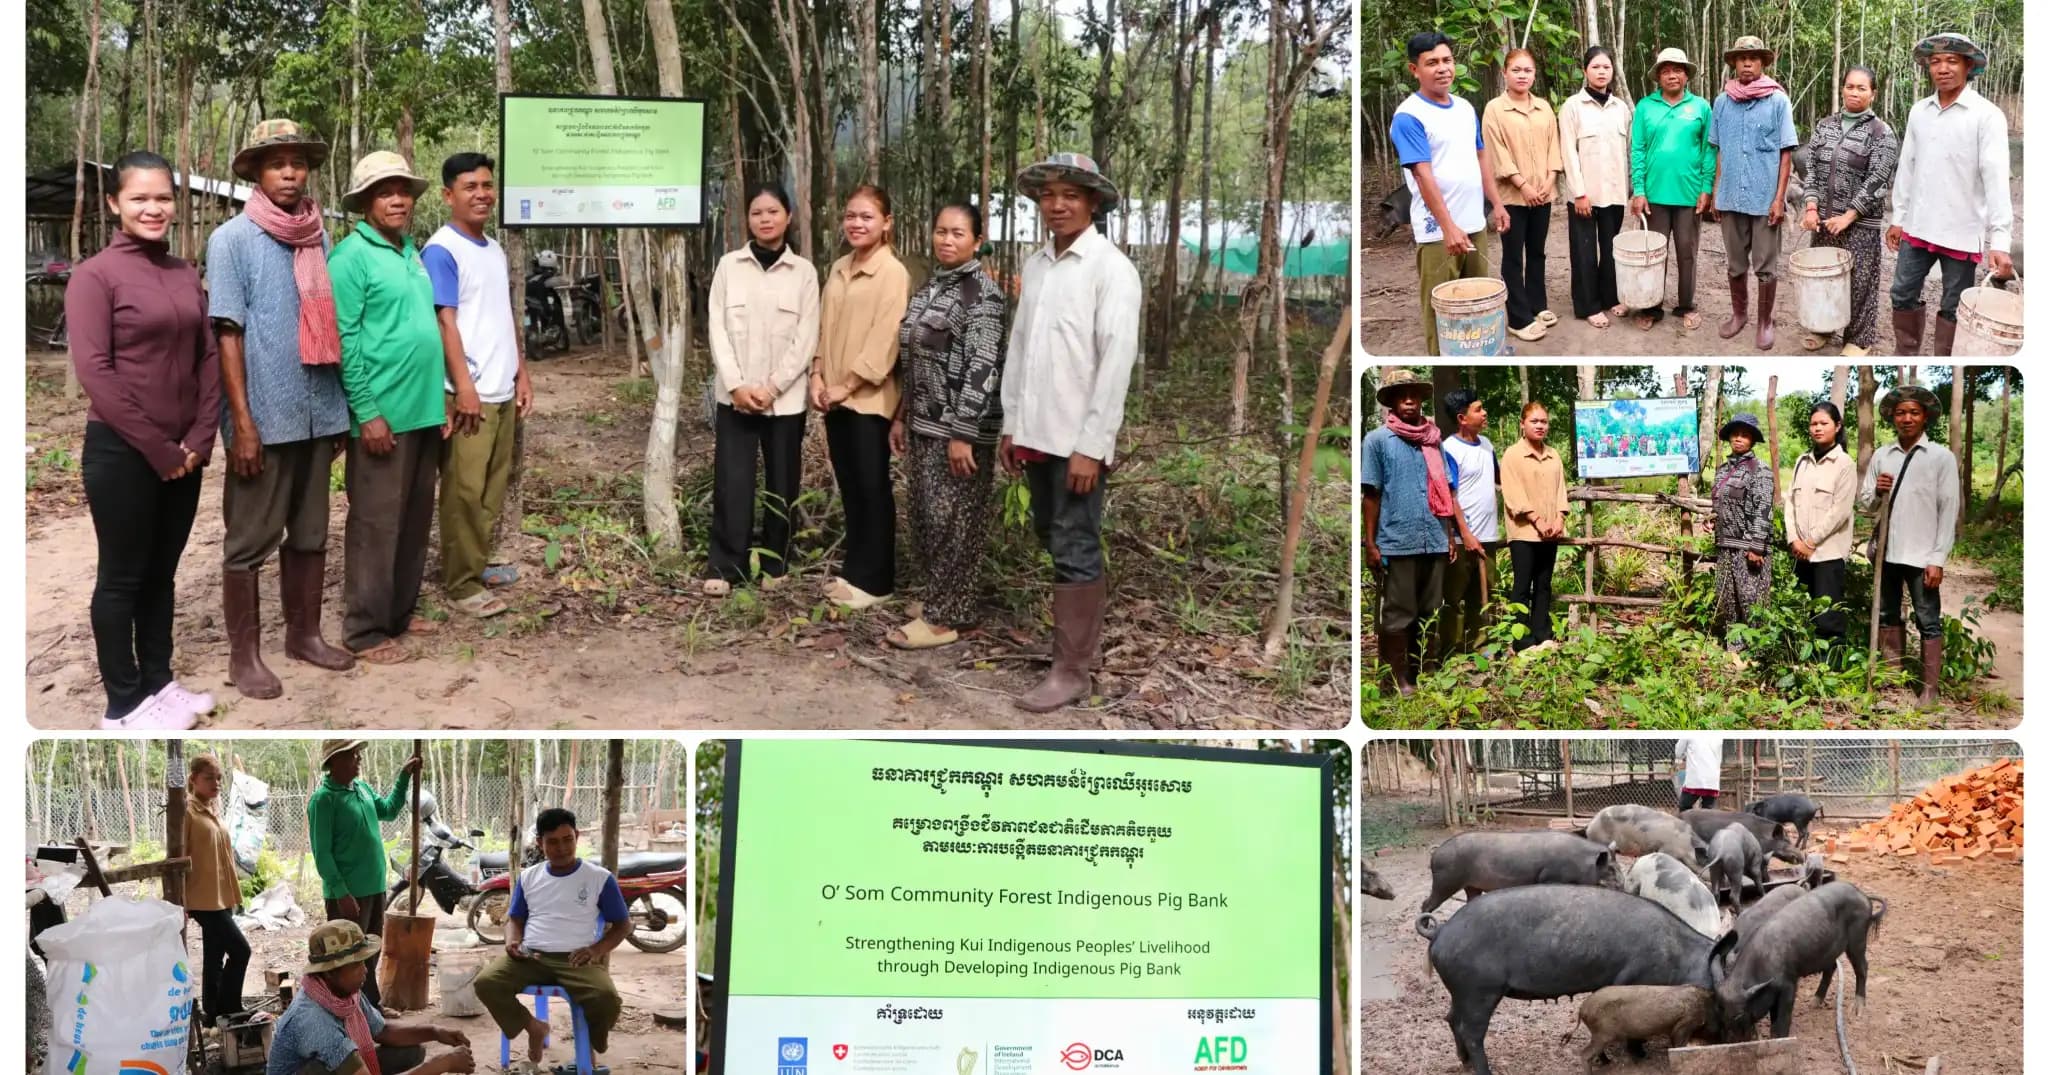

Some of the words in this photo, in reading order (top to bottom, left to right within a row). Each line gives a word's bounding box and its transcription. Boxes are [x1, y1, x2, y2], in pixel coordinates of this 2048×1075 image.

[845, 885, 884, 900] Som
[891, 886, 993, 907] Community
[1000, 889, 1052, 904] Forest
[1058, 890, 1152, 909] Indigenous
[1158, 893, 1182, 911] Pig
[1189, 893, 1228, 907] Bank
[846, 936, 954, 954] Strengthening
[961, 938, 983, 951] Kui
[988, 938, 1071, 955] Indigenous
[1140, 941, 1209, 953] Livelihood
[878, 959, 938, 976] through
[945, 960, 1028, 977] Developing
[1033, 961, 1115, 978] Indigenous
[1121, 962, 1141, 978] Pig
[1147, 962, 1181, 975] Bank
[1094, 1049, 1124, 1061] DCA
[1194, 1036, 1248, 1064] AFD
